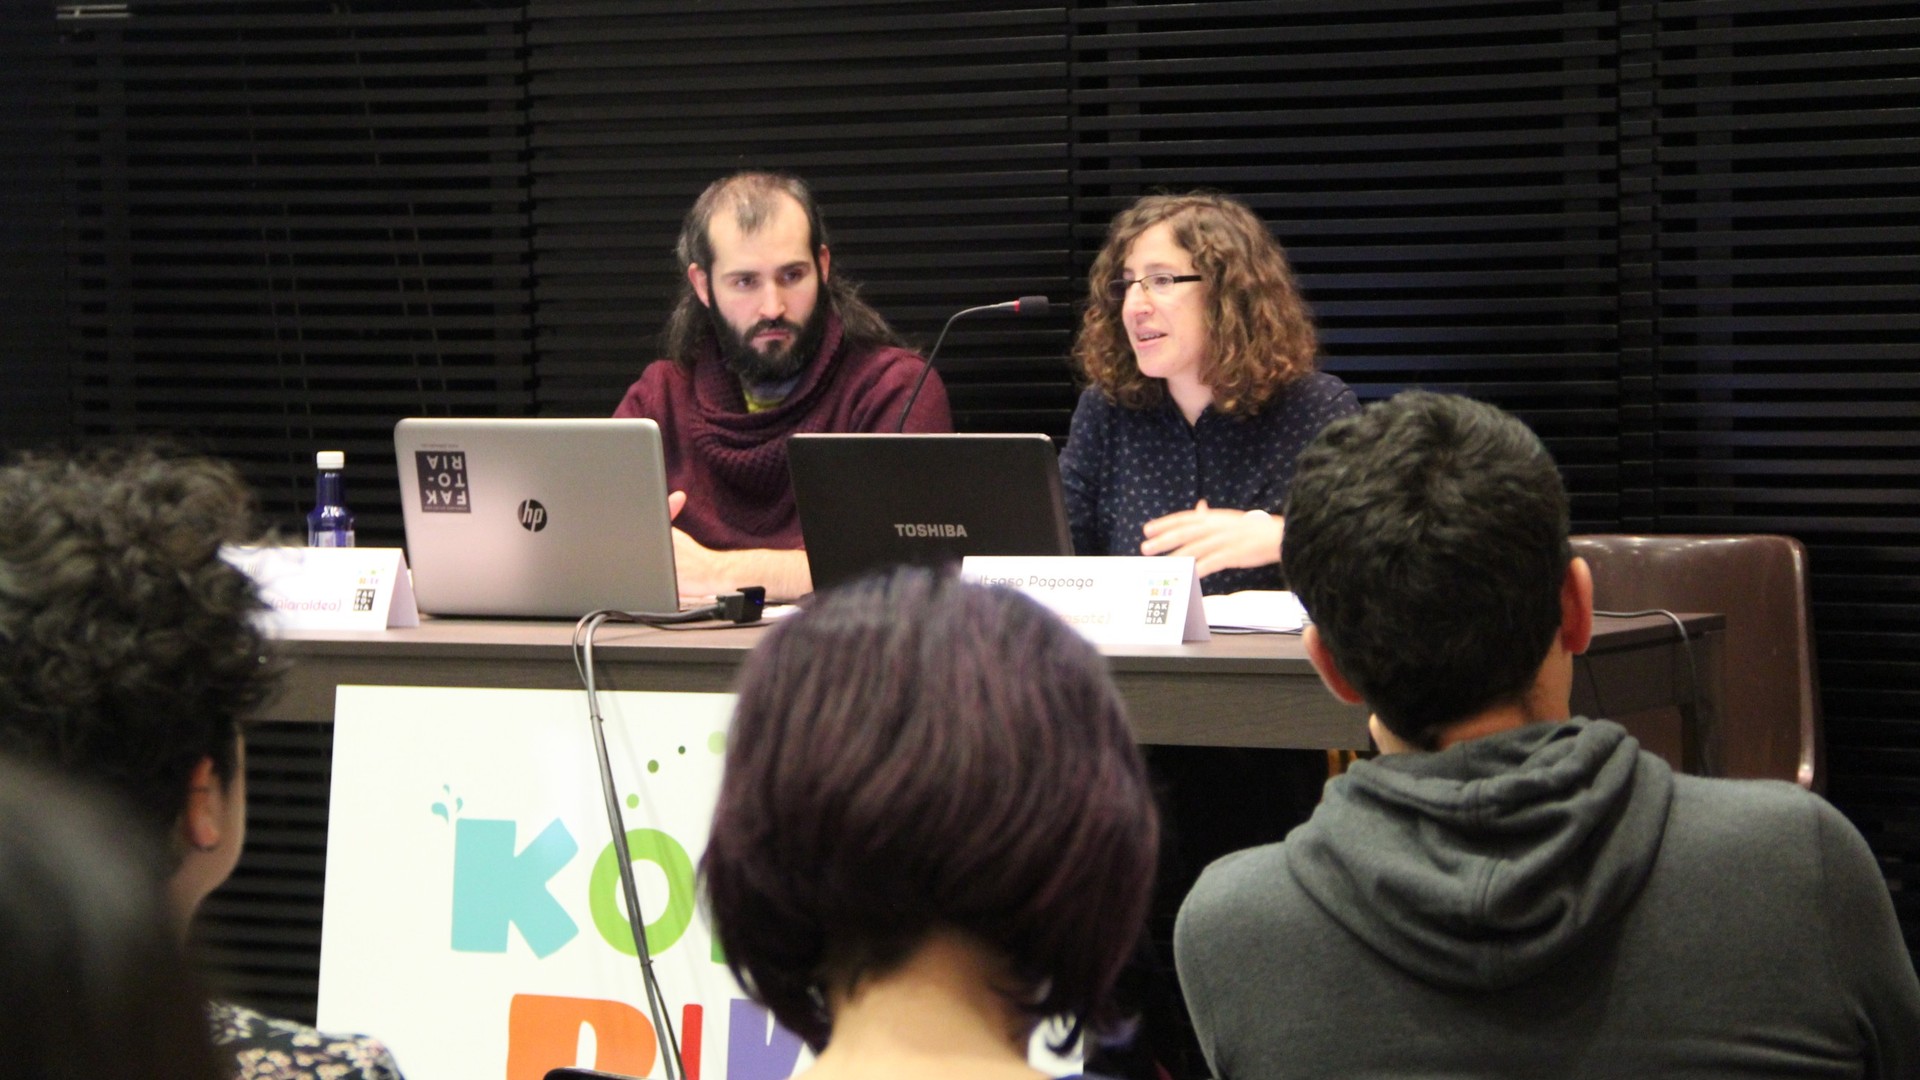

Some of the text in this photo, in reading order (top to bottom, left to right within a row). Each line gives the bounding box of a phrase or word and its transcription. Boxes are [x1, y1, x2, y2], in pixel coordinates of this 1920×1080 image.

[426, 455, 463, 470] RIA
[425, 490, 467, 505] FAK
[520, 499, 545, 532] hp
[894, 524, 968, 537] TOSHIBA
[1029, 575, 1094, 590] Pagoaga
[1148, 602, 1168, 610] FAK
